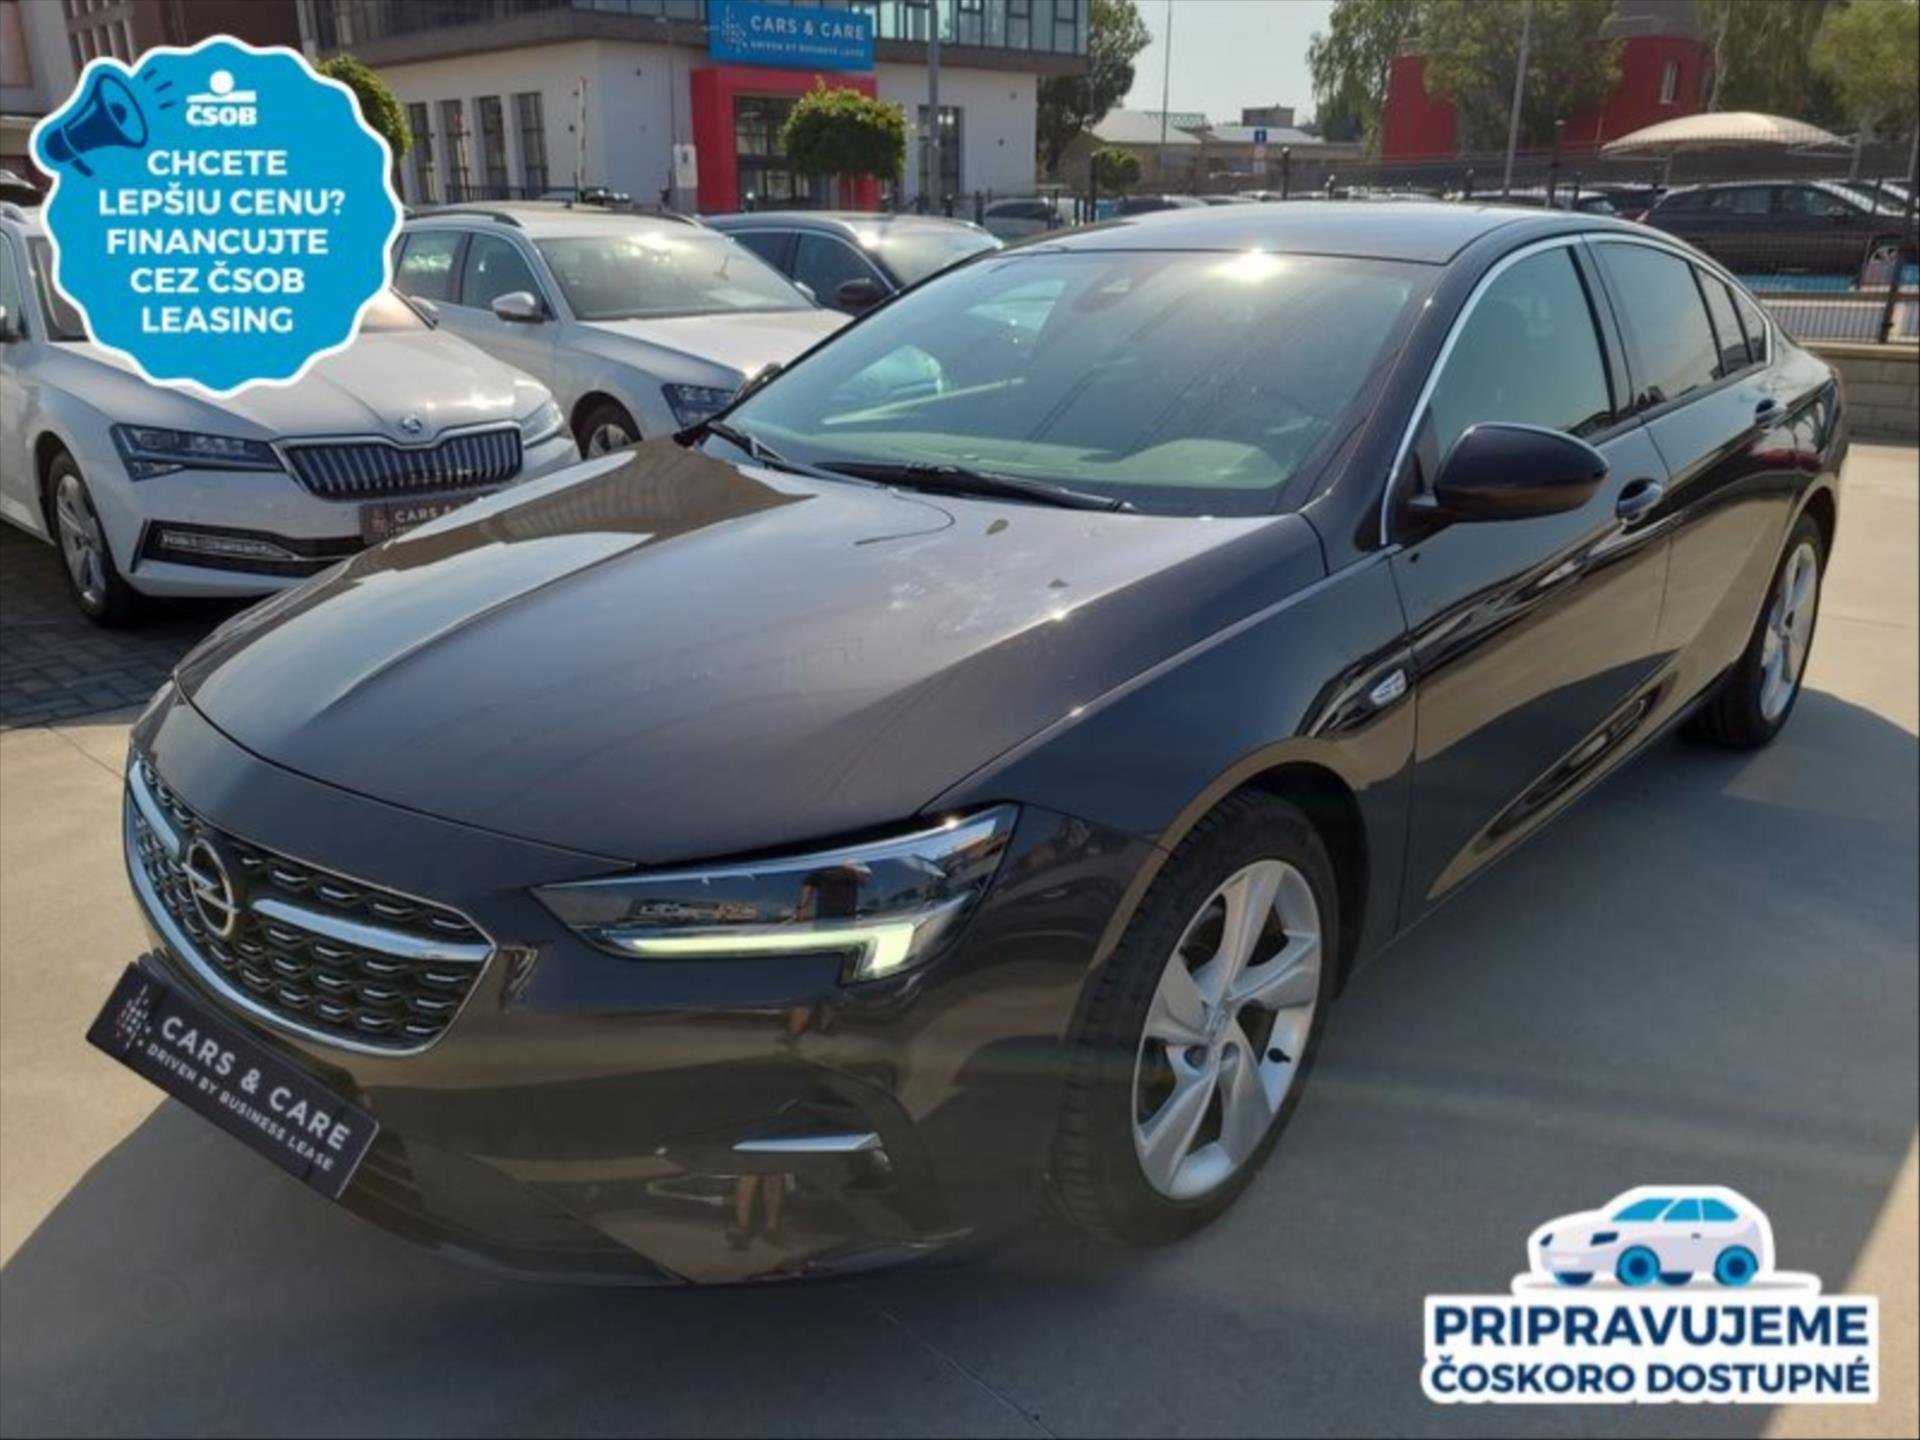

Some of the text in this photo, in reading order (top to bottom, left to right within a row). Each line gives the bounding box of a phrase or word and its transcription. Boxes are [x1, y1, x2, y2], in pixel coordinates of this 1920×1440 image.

[751, 15, 864, 41] CARS & CARE
[395, 506, 437, 523] CARS
[147, 1043, 334, 1171] DRIVEN BY BUSINESS LEASE
[162, 1016, 351, 1150] CARS & CARE
